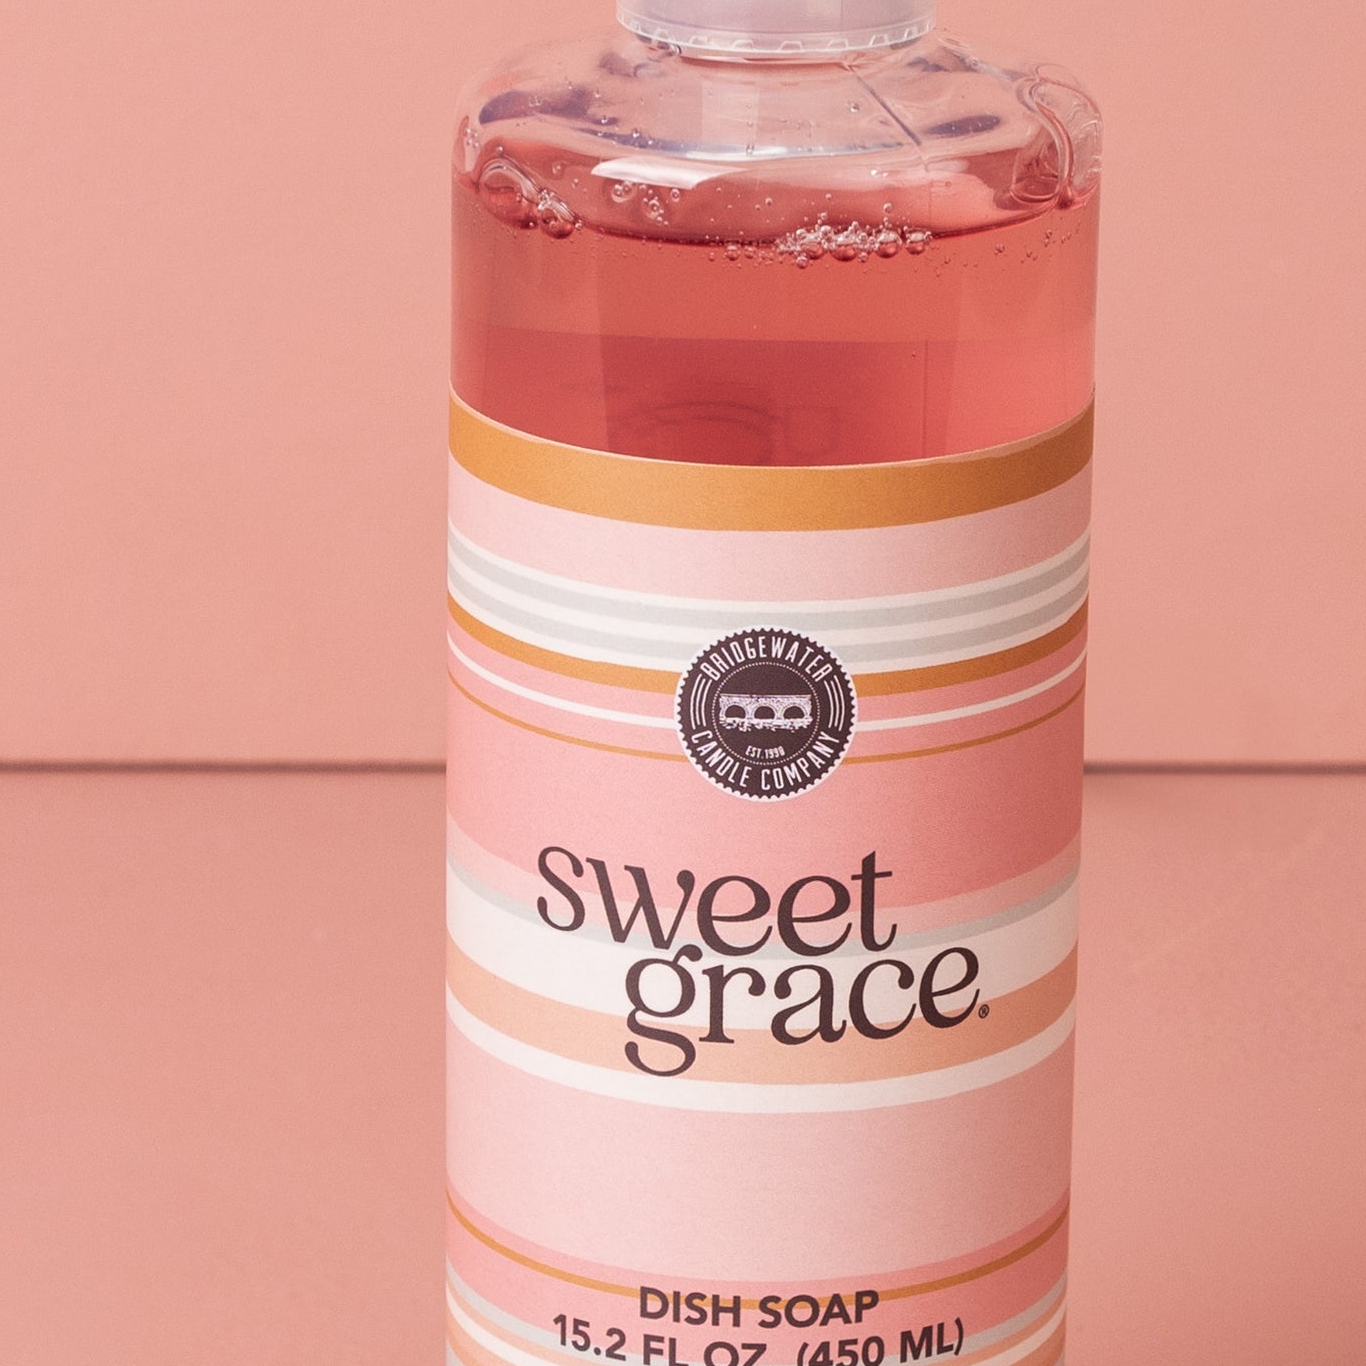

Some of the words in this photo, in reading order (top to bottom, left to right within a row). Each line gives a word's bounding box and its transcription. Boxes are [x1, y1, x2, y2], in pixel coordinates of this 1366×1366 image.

[700, 636, 833, 682] BRIDGEWATER
[691, 730, 752, 787] CANDLE
[761, 731, 840, 791] COMPANY
[536, 846, 897, 957] sweet
[639, 1286, 741, 1327] DISH
[758, 1290, 879, 1329] SOAP
[553, 1314, 627, 1362] 15.2
[899, 1318, 964, 1364] ML)
